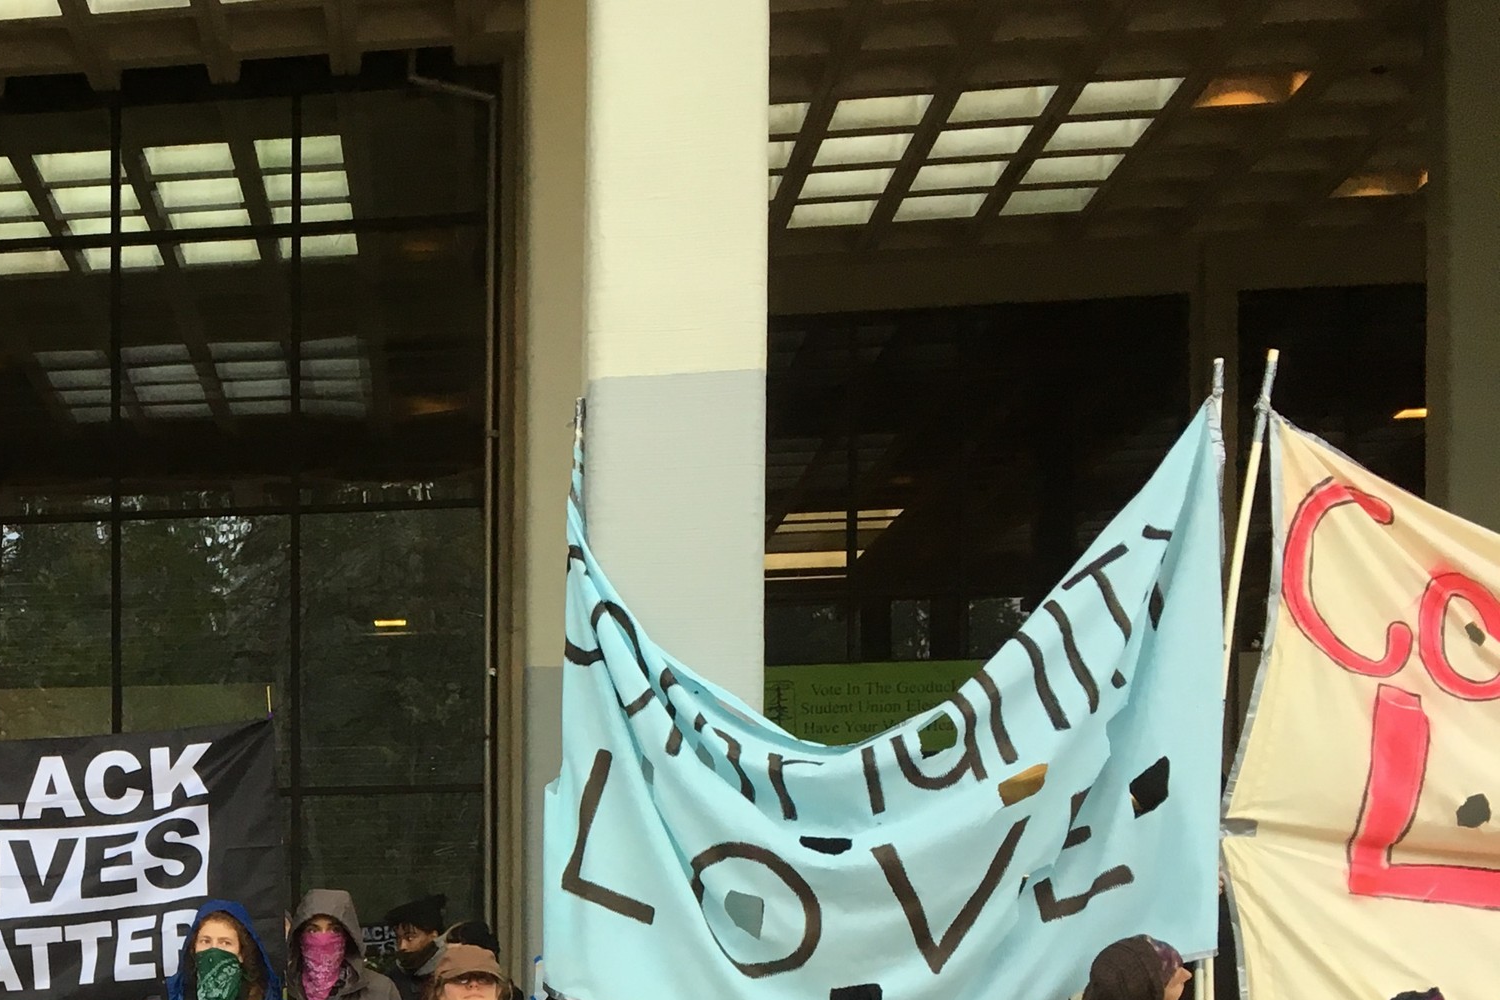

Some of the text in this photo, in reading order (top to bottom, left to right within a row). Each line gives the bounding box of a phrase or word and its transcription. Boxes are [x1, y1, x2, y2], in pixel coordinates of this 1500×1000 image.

[811, 682, 843, 696] Vote
[846, 682, 861, 695] In
[864, 681, 893, 695] The
[801, 700, 855, 715] Student
[858, 700, 904, 714] Union
[803, 720, 842, 735] Have
[844, 719, 879, 734] Your
